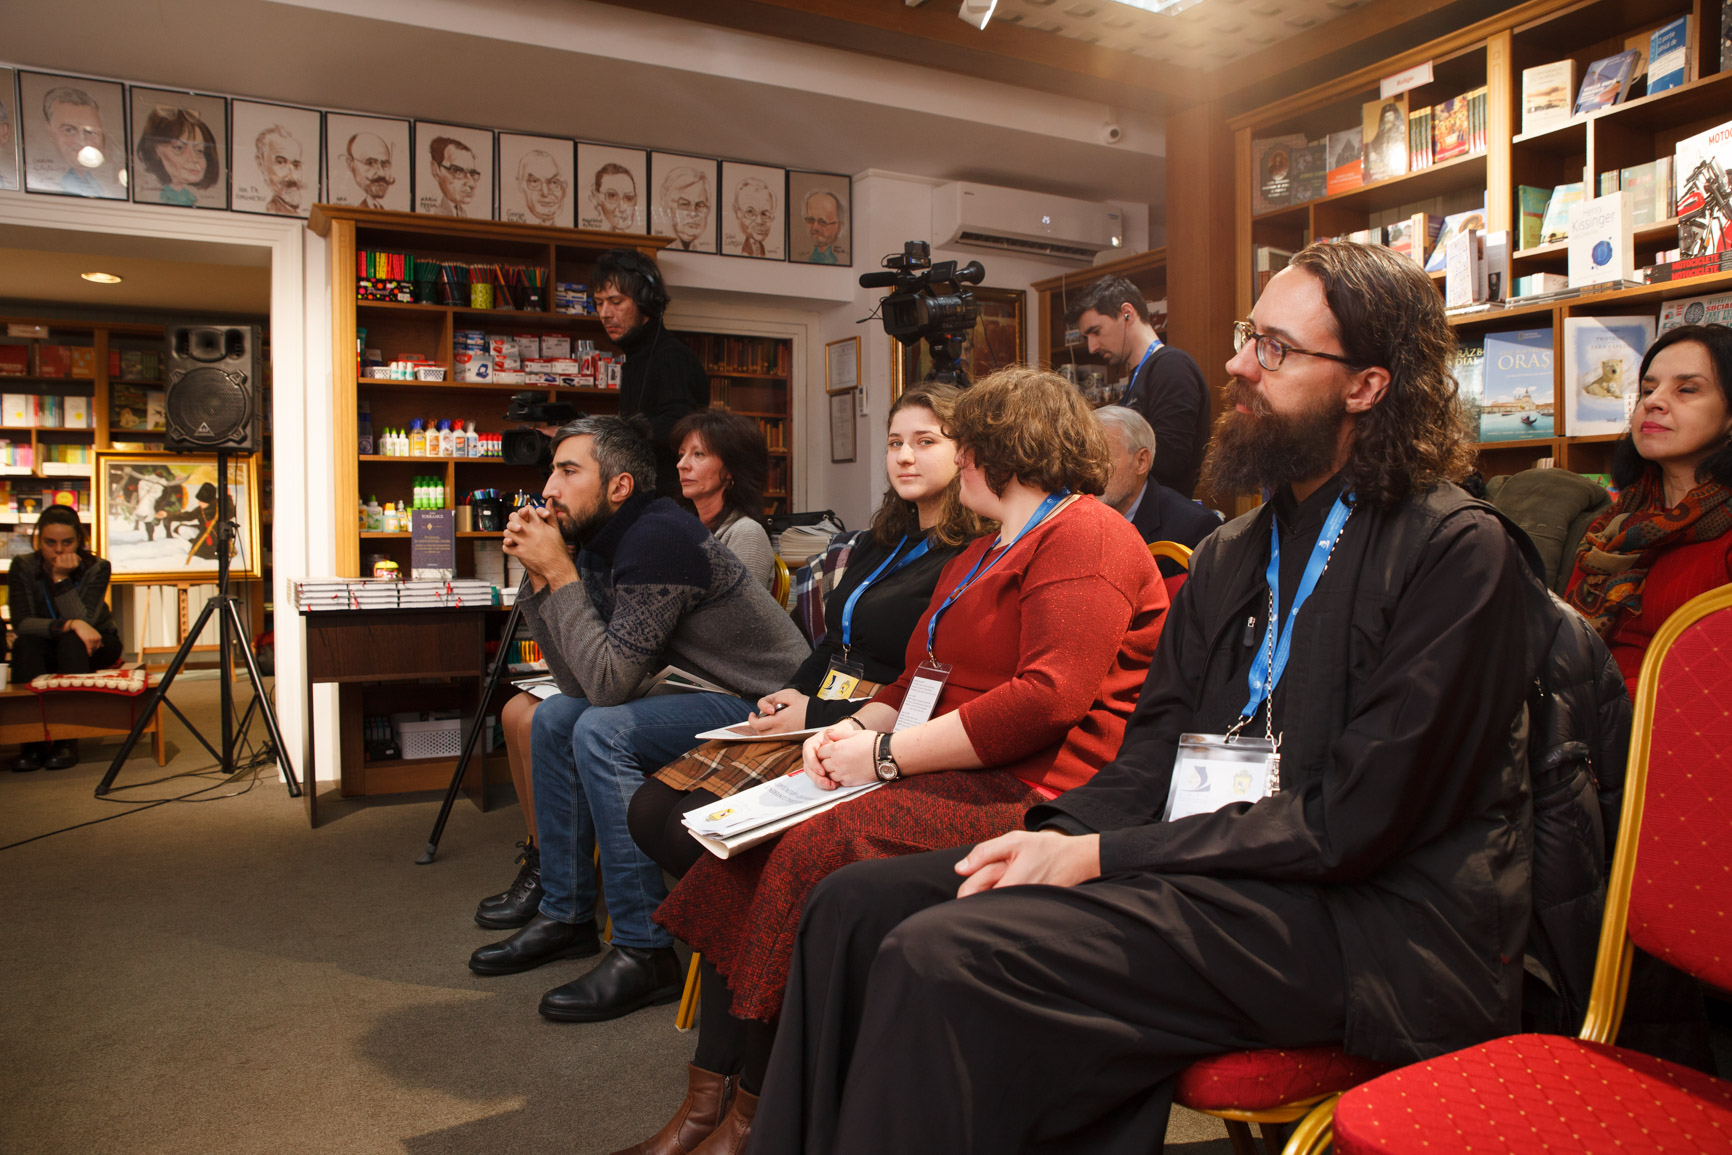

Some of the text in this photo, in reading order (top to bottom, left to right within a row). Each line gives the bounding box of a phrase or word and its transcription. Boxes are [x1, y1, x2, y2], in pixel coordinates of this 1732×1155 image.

[1583, 206, 1602, 218] Henry
[1572, 211, 1616, 233] Kissinger
[1672, 254, 1720, 271] MOTOCICLETE
[1672, 264, 1720, 281] MOTOCICLETE
[1456, 347, 1484, 358] RĂZB
